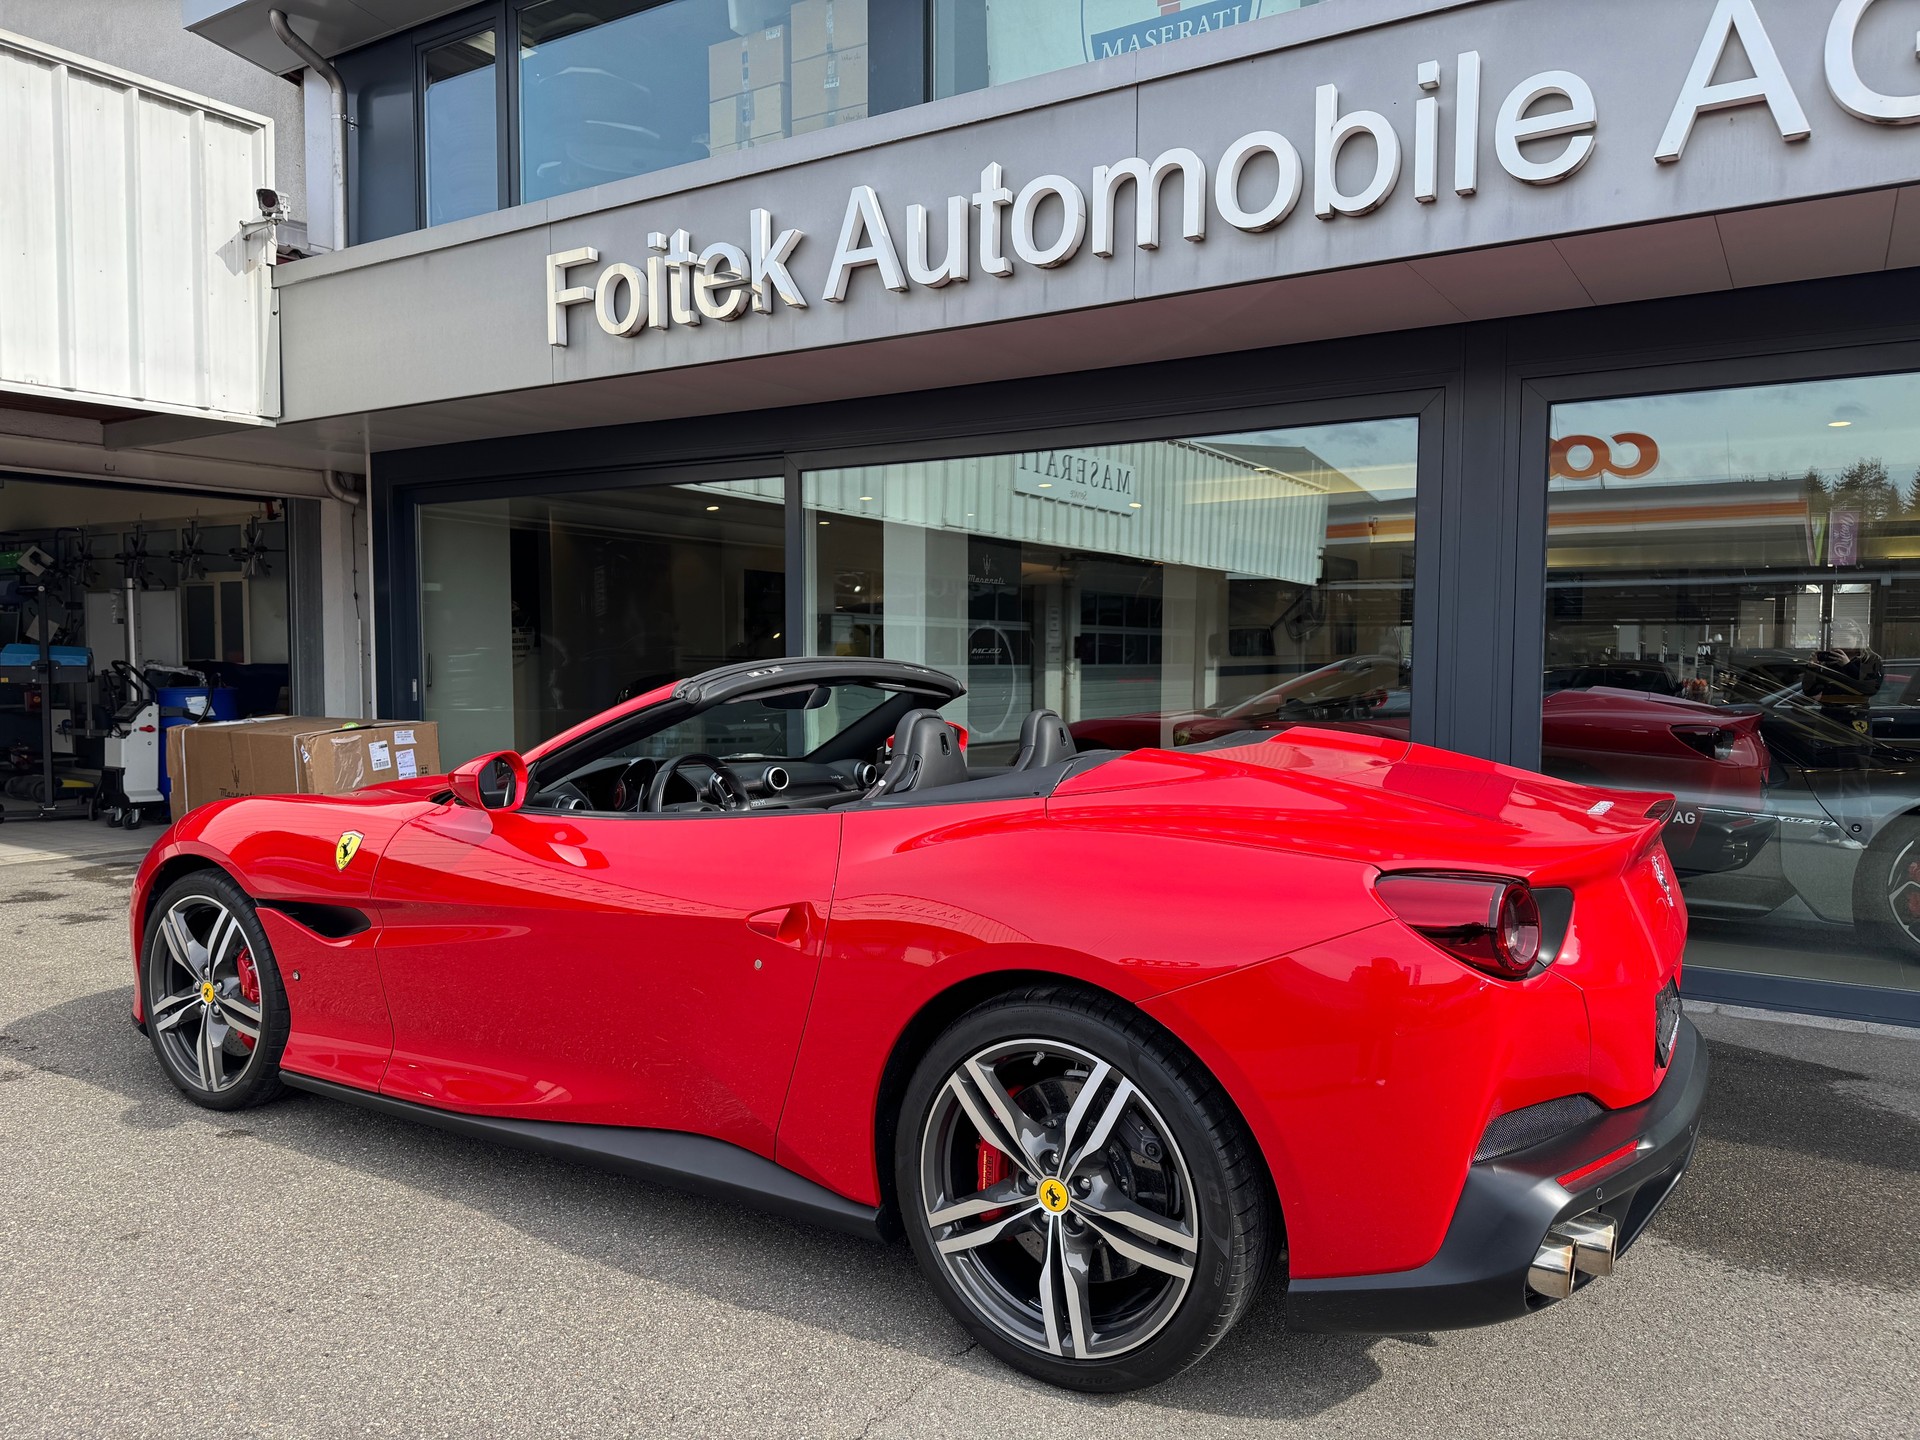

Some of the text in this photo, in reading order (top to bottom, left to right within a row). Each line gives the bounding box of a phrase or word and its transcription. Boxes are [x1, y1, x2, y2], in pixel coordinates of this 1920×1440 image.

[1102, 4, 1243, 59] MASERATI
[546, 208, 809, 347] Foitek
[822, 50, 1598, 303] Automobile
[1672, 811, 1696, 825] AG
